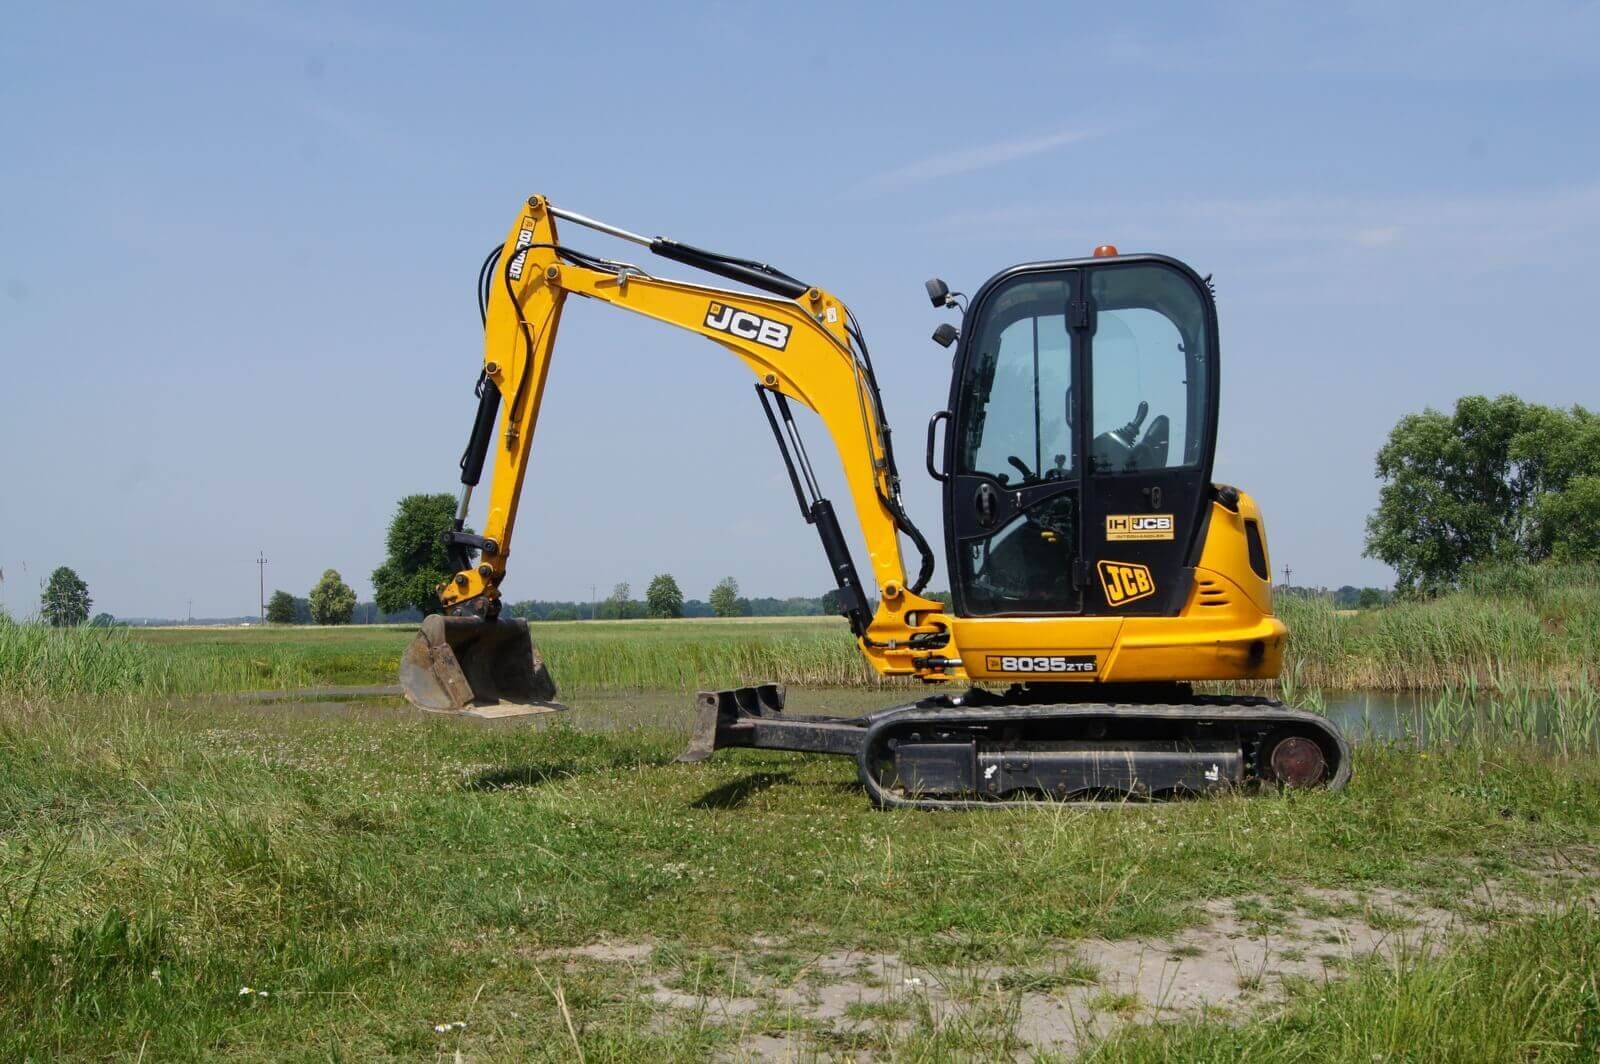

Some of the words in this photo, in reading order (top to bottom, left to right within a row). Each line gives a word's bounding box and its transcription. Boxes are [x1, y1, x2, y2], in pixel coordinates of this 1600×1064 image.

[706, 307, 788, 348] JCB
[1109, 519, 1126, 529] IH
[1132, 518, 1170, 529] JCB
[1106, 565, 1150, 600] JCB
